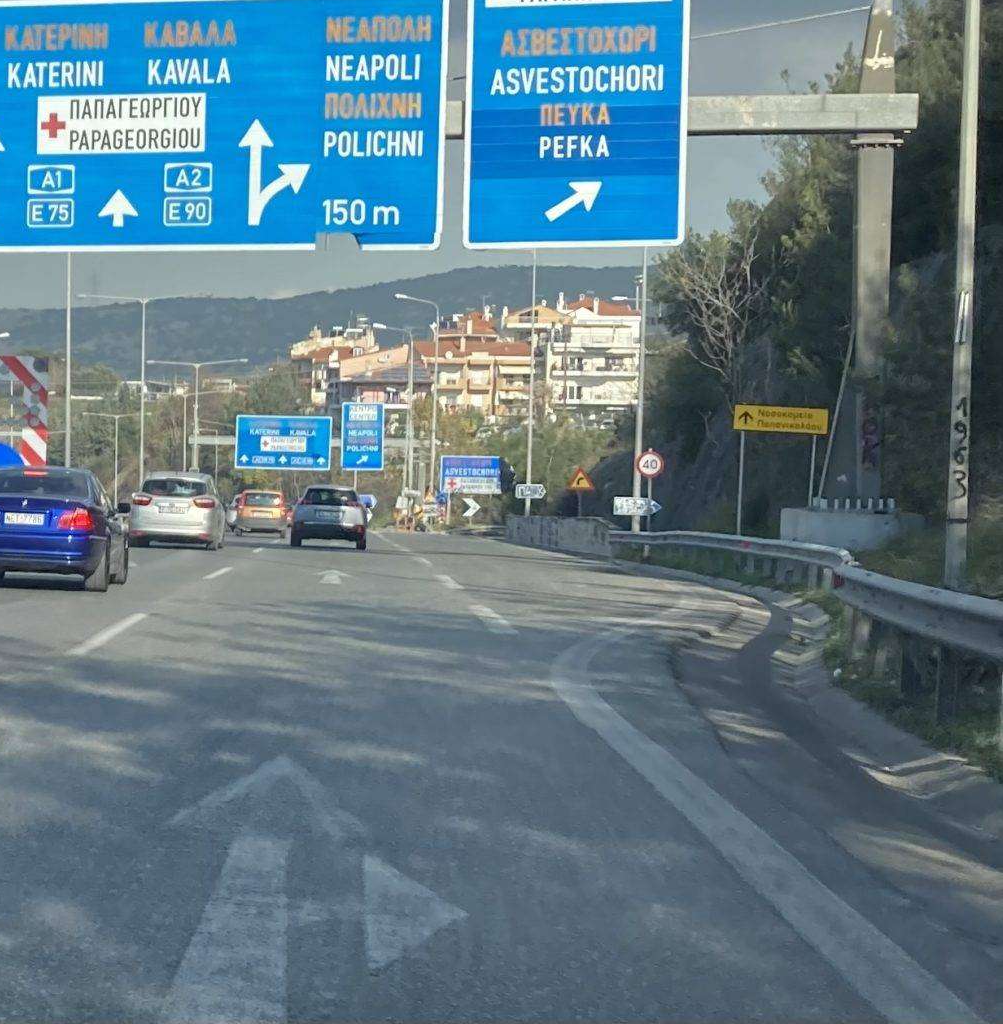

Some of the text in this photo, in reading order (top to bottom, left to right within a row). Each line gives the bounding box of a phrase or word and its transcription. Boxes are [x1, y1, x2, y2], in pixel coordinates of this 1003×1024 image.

[4, 23, 109, 51] ΚΑΤΕΡΙΝΗ
[144, 20, 237, 48] ΚΑΒΑΛΑ
[326, 15, 432, 43] ΝΕΑΠΟΛΗ
[7, 61, 104, 88] KATERINI
[148, 58, 231, 85] KAVALA
[326, 54, 421, 82] NEAPOLI
[490, 64, 663, 96] ASVESTOCHORI
[70, 97, 202, 119] ΠΑΠΑΓΕΩΡΓΙΟΥ
[324, 93, 422, 119] ΠΟΛΙΧΝΗ
[540, 103, 610, 127] ΠΕΥΚΑ
[69, 128, 201, 150] PAPAGEORGIOU
[323, 130, 423, 157] POLICHNI
[539, 134, 610, 159] PEFKA
[41, 171, 62, 188] A1
[175, 169, 202, 186] A2
[48, 204, 70, 221] 75
[184, 202, 206, 220] 90
[322, 199, 400, 226] 150 m
[642, 460, 658, 469] 40
